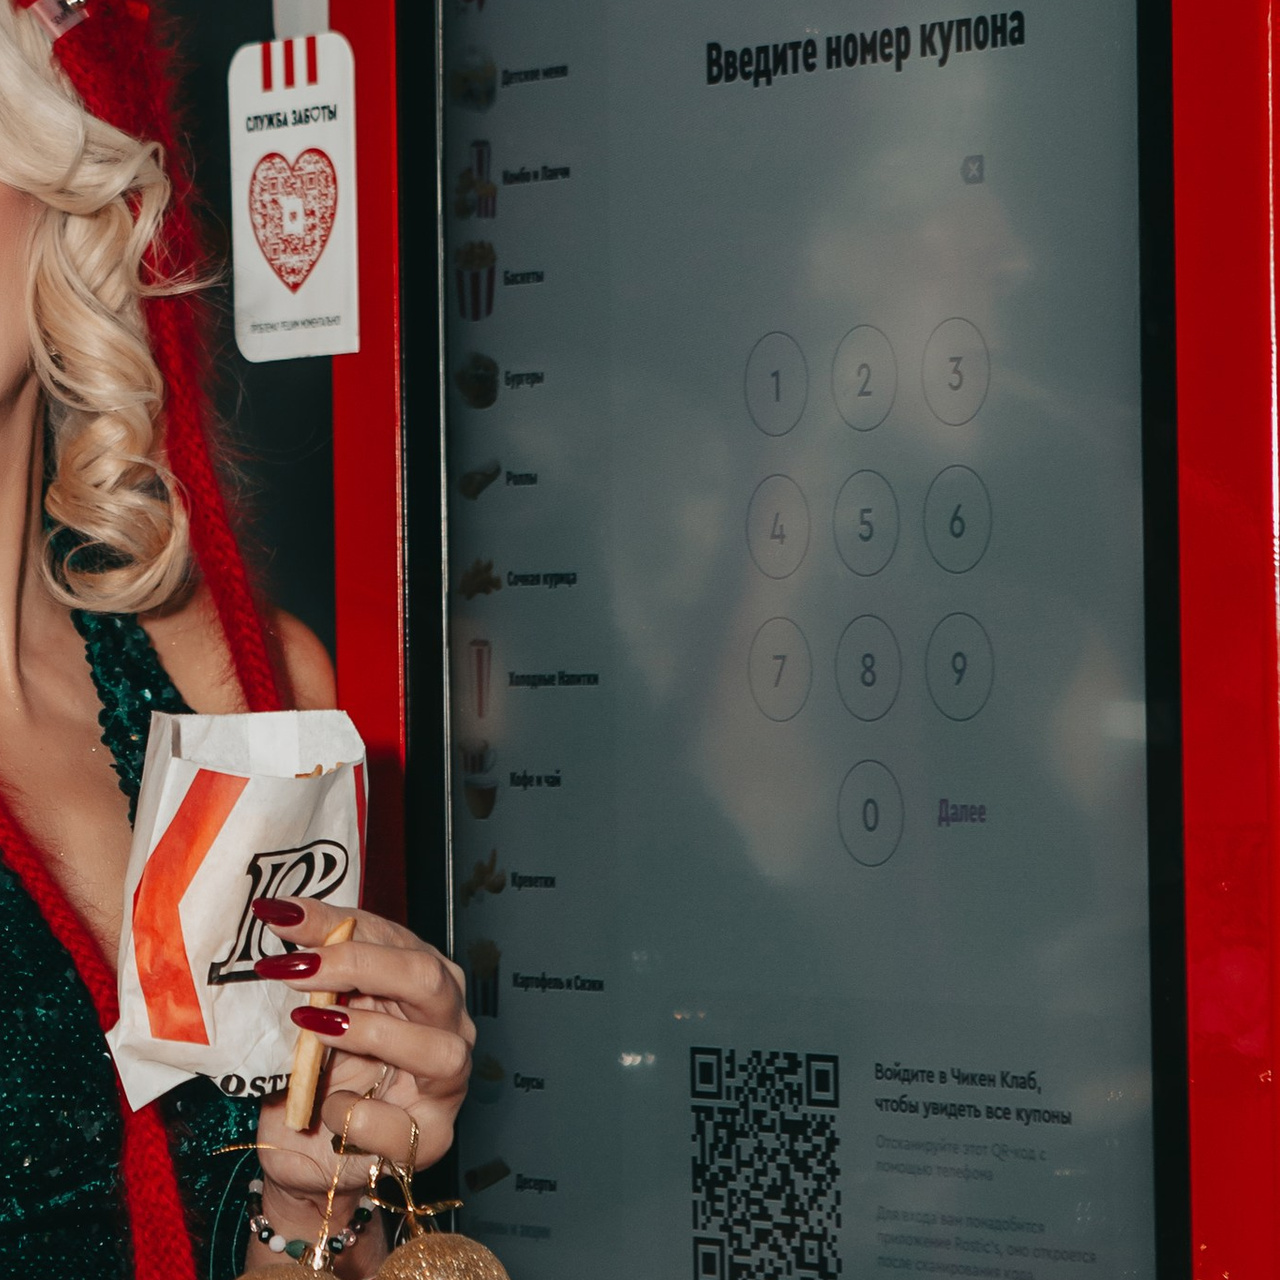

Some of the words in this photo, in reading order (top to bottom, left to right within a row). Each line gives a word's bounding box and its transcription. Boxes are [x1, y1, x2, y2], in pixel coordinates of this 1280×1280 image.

[706, 38, 817, 89] Введите
[826, 25, 911, 73] номер
[920, 9, 1026, 68] купона
[246, 111, 289, 133] СЛУЖБА
[505, 370, 545, 390] Бургеры
[770, 369, 782, 403] 1
[857, 363, 873, 398] 2
[948, 356, 964, 392] 3
[770, 511, 786, 546] 4
[858, 508, 874, 543] 5
[949, 504, 966, 539] 6
[772, 654, 787, 689] 7
[860, 653, 877, 687] 8
[952, 651, 968, 687] 9
[509, 769, 535, 791] Кофе
[862, 798, 879, 833] 0
[937, 797, 987, 828] Далее
[511, 871, 556, 891] Креветки
[512, 972, 565, 993] Картофель
[875, 1062, 935, 1086] Войдите
[939, 1070, 947, 1084] в
[950, 1067, 996, 1088] Чикен
[1000, 1071, 1041, 1095] Клаб,
[875, 1094, 919, 1114] чтобы
[922, 1101, 982, 1120] увидеть
[985, 1105, 1011, 1121] все
[1016, 1107, 1072, 1126] купоны
